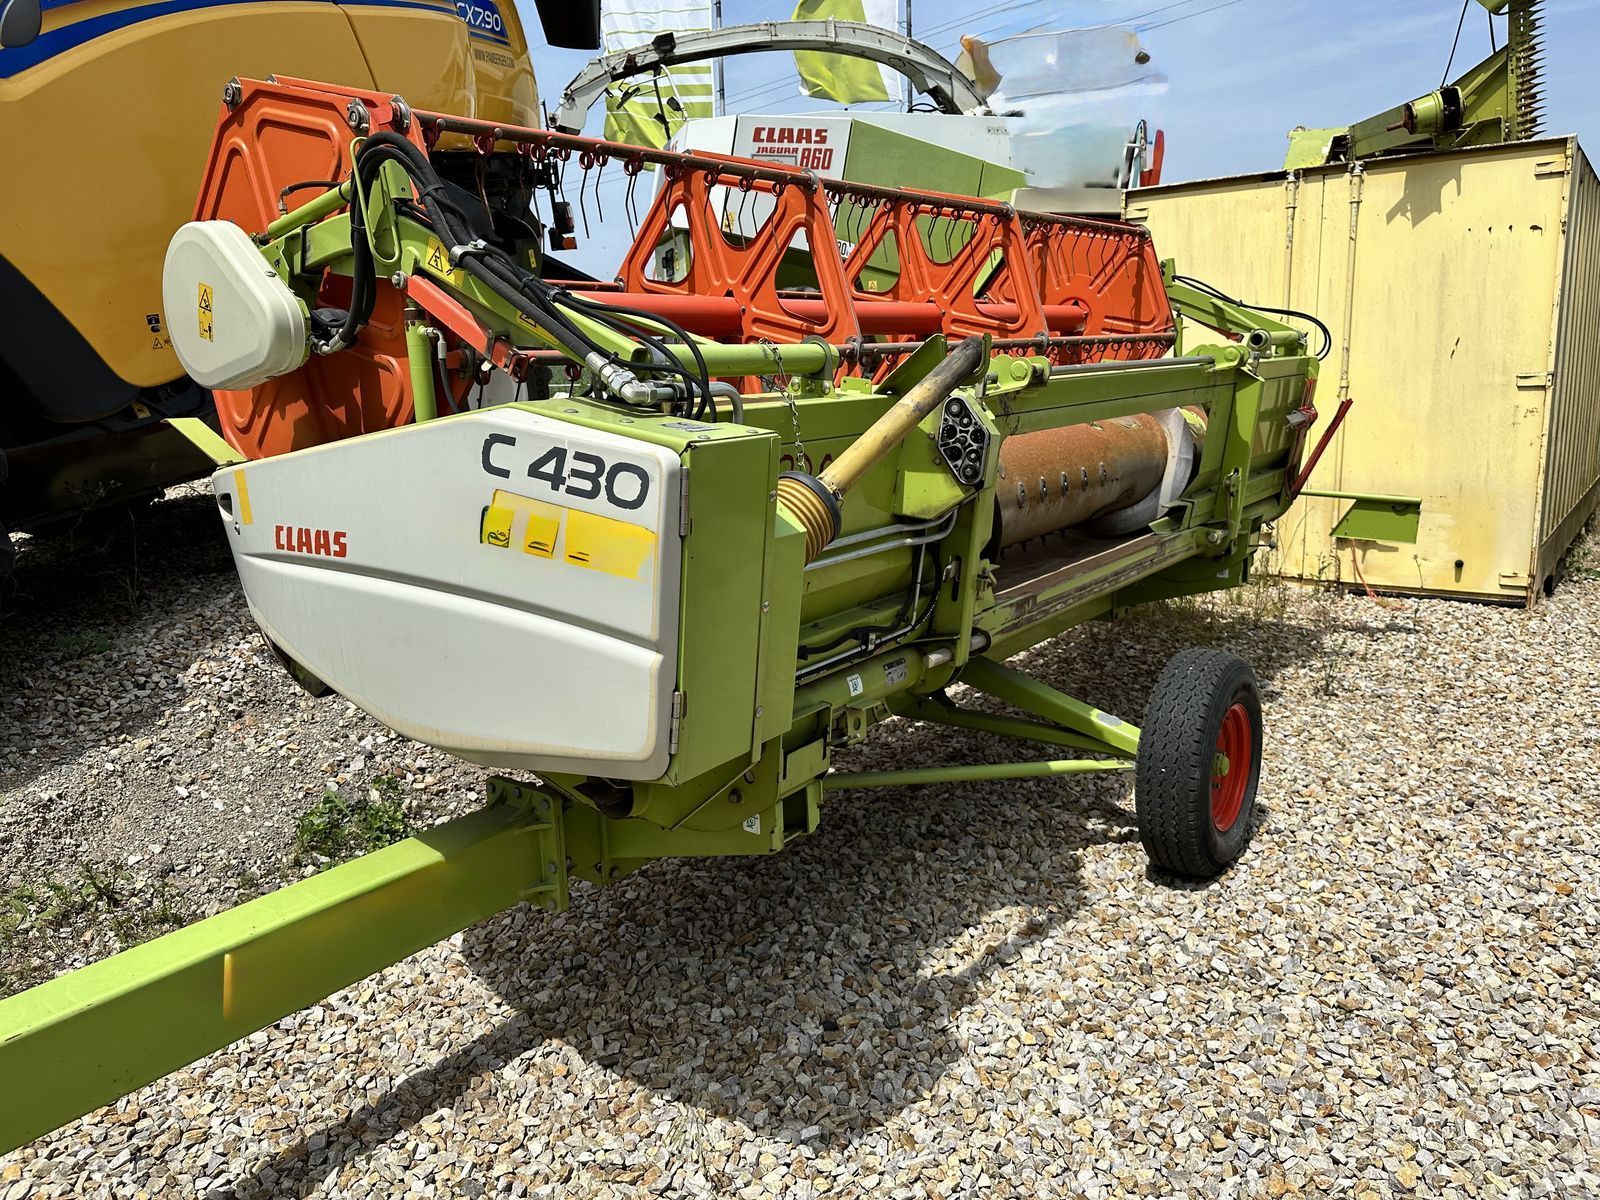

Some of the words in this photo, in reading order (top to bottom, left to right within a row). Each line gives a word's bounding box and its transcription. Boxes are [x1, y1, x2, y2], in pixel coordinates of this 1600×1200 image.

[457, 2, 501, 31] CX7.90
[752, 127, 828, 144] CLAAS
[755, 146, 799, 154] JAGUAR
[799, 147, 834, 170] 860
[481, 433, 517, 479] C
[527, 446, 650, 510] 430
[275, 525, 347, 558] CLAAS
